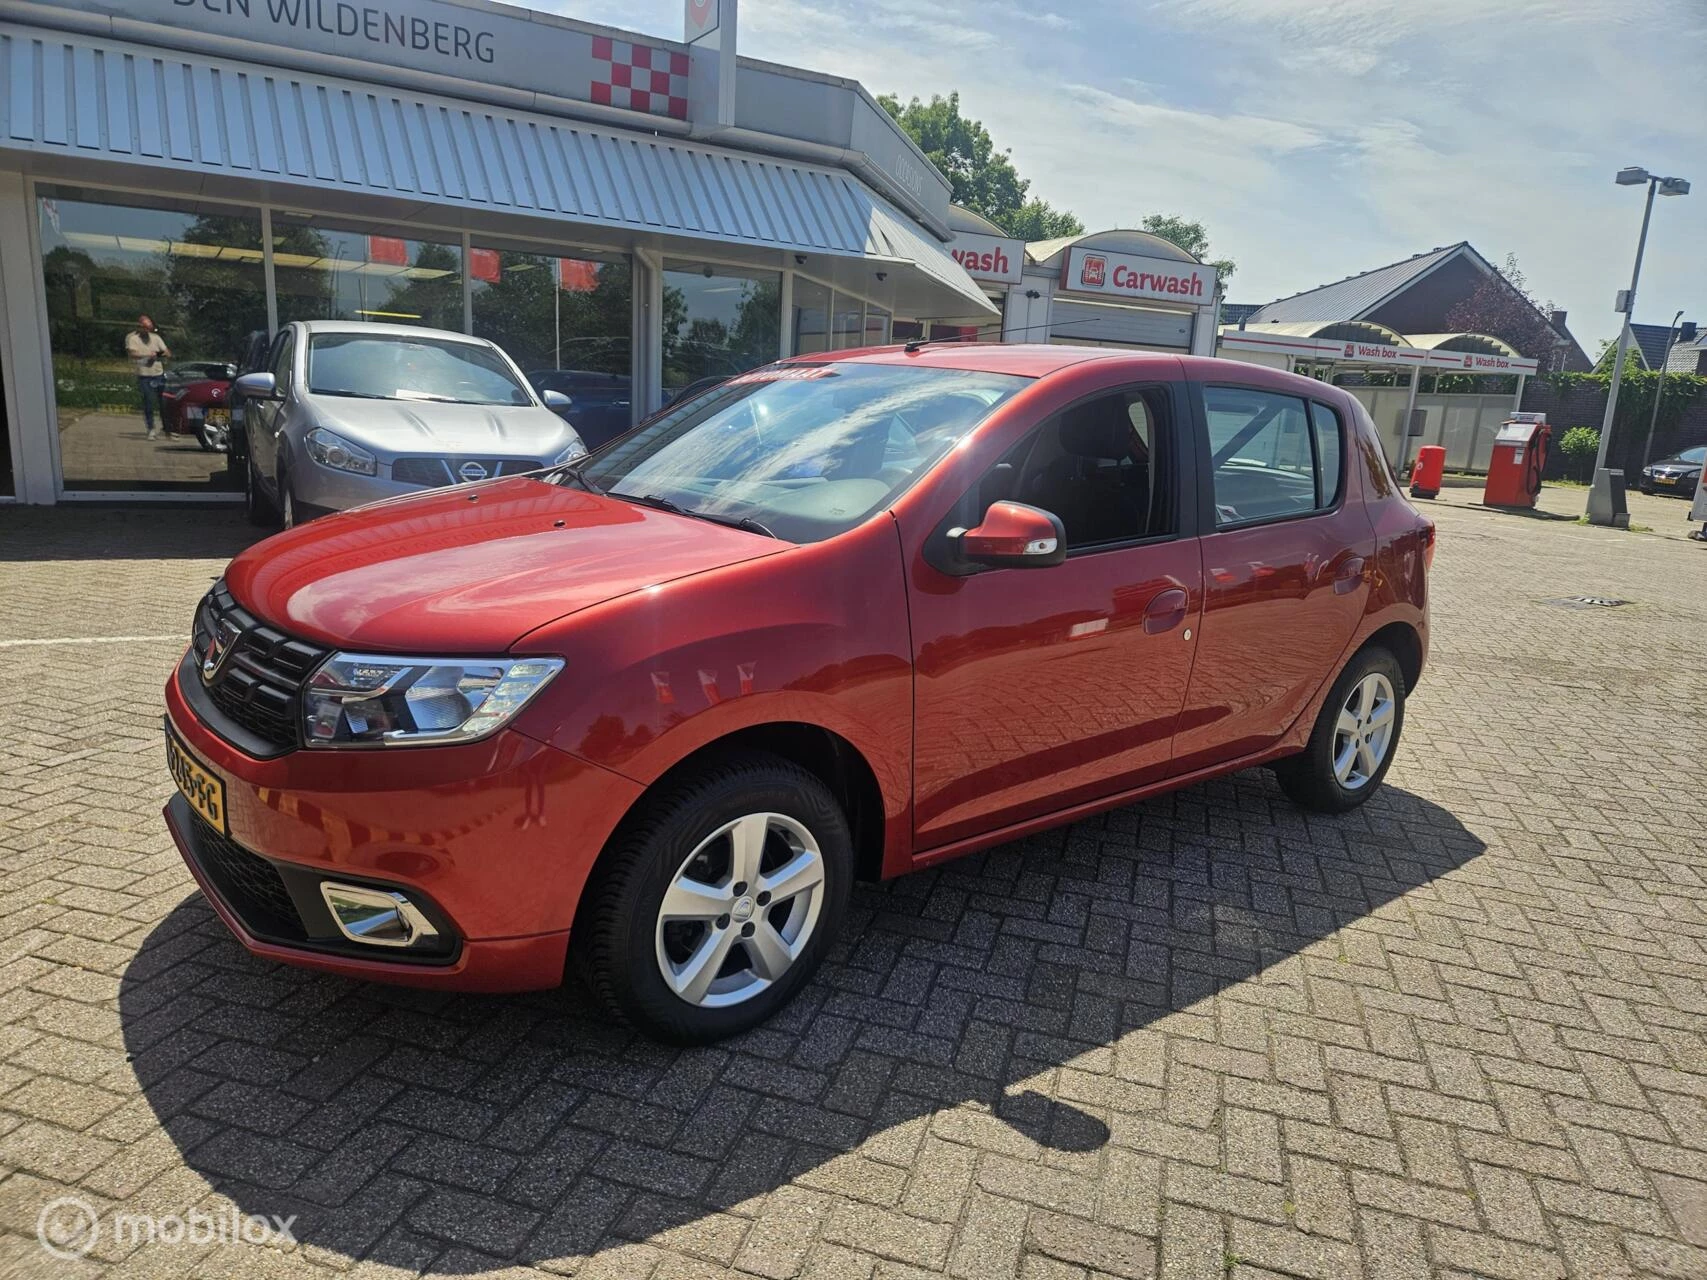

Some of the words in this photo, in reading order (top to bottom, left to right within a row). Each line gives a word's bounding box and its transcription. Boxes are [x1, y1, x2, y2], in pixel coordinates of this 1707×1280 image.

[266, 0, 495, 64] WILDENBERG
[1112, 265, 1203, 297] Carwash
[1358, 345, 1381, 358] Wash
[1382, 347, 1398, 359] box
[1475, 357, 1496, 367] Wash
[1496, 358, 1509, 369] box
